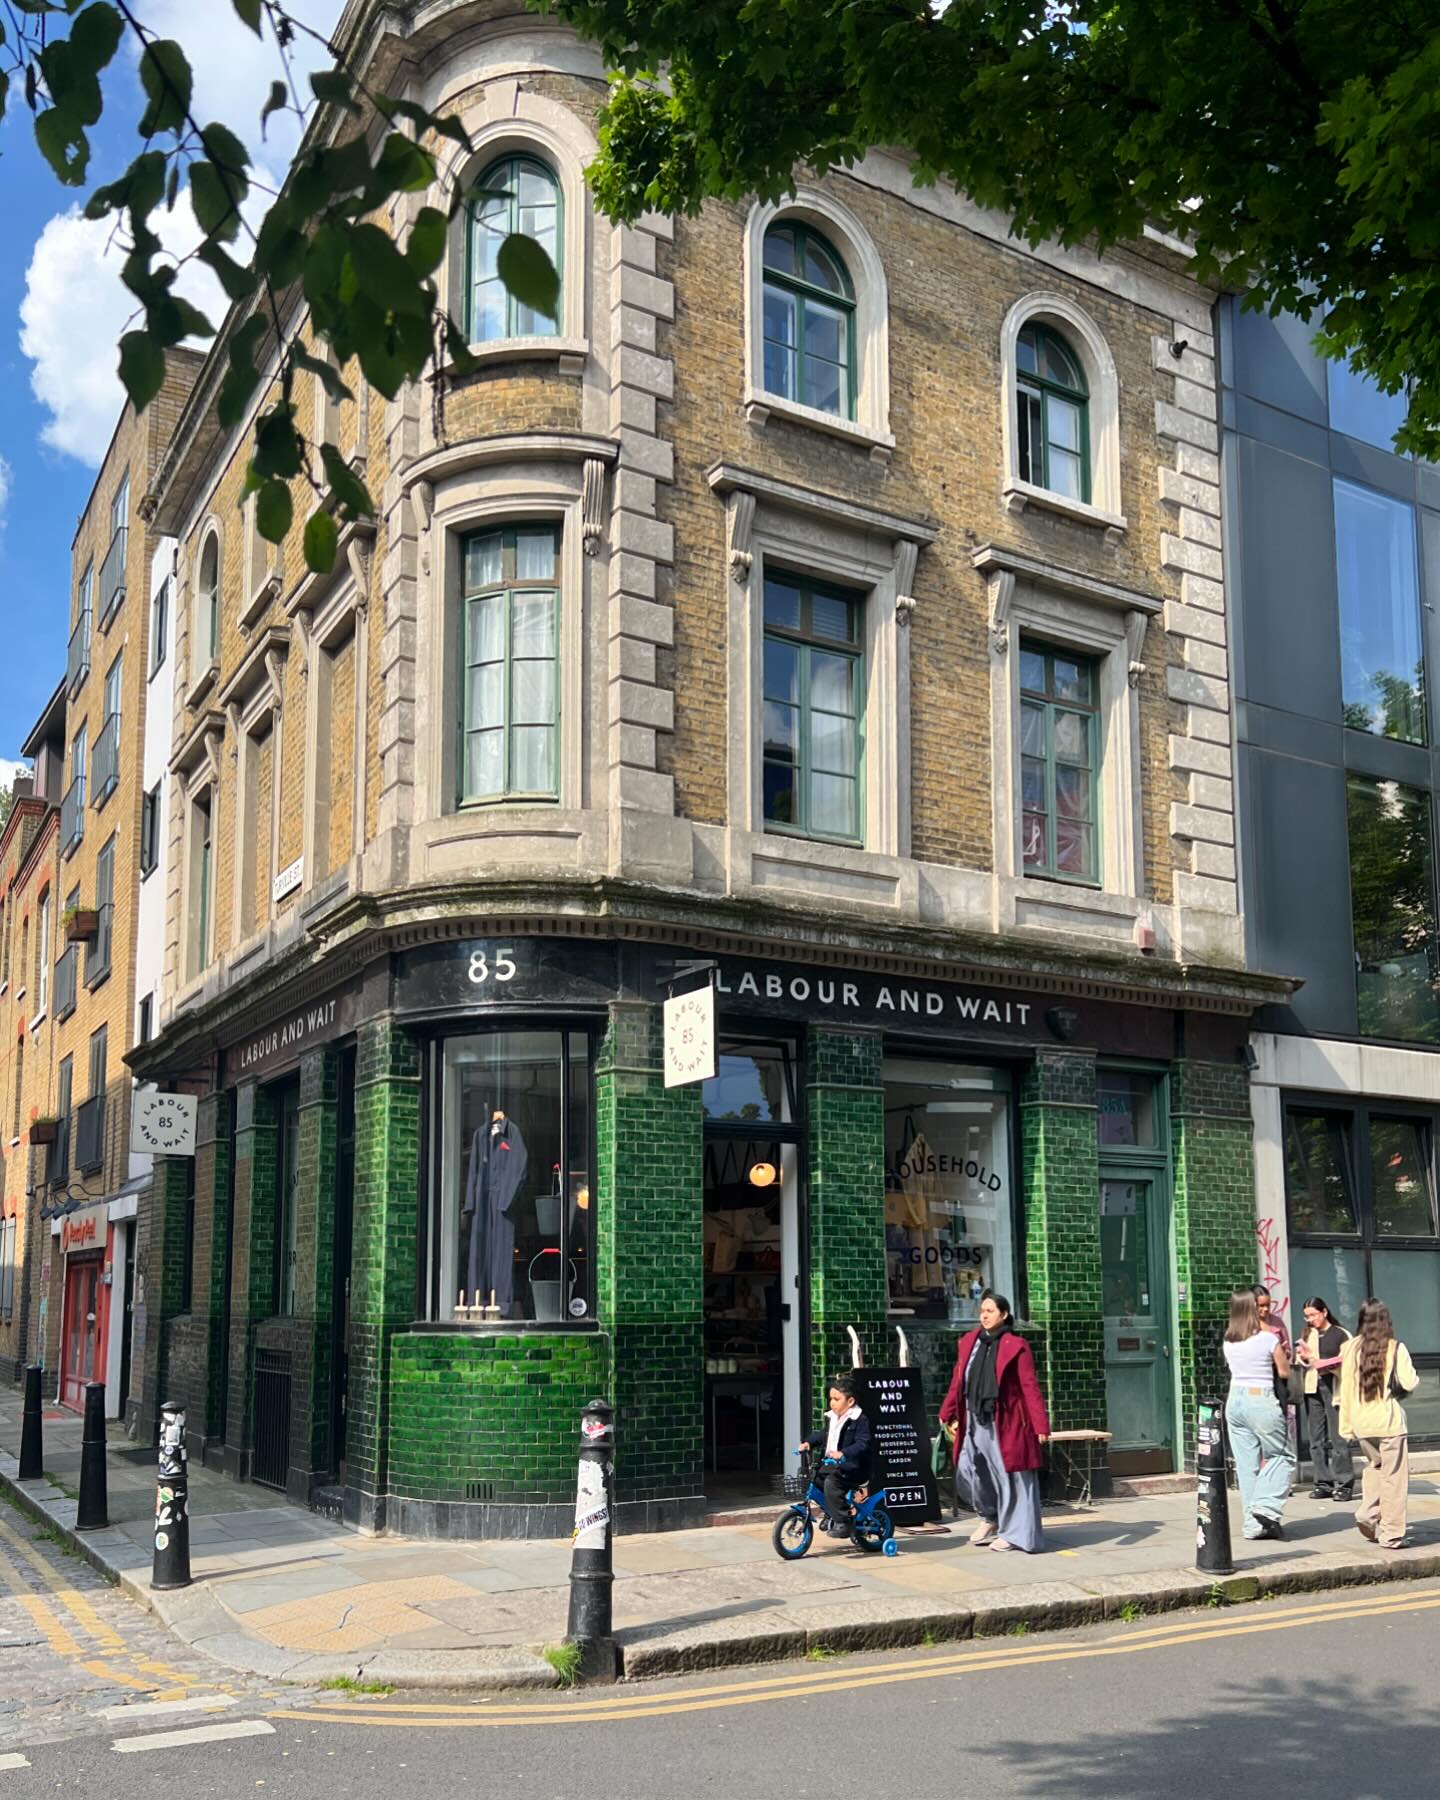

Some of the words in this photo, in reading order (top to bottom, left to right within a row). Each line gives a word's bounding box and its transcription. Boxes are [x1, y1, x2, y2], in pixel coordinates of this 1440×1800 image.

[468, 948, 517, 984] 85
[716, 968, 860, 1007] LABOUR
[875, 987, 944, 1016] AND
[956, 996, 1031, 1026] WAIT
[670, 1000, 707, 1032] LABOUR
[241, 1031, 278, 1069] LABOUR
[280, 1017, 304, 1048] AND
[307, 999, 336, 1033] WAIT
[682, 1027, 694, 1045] 85
[669, 1046, 684, 1072] AND
[687, 1040, 708, 1072] WAIT
[143, 1098, 189, 1119] LABOUR
[158, 1116, 173, 1128] 85
[140, 1124, 159, 1145] AND
[162, 1127, 190, 1148] WAIT
[909, 1246, 983, 1265] GOODS
[868, 1379, 910, 1389] LABOUR
[881, 1392, 903, 1401] AND
[879, 1404, 907, 1413] WAIT
[886, 1471, 904, 1479] SINCE
[889, 1491, 922, 1502] OPEN
